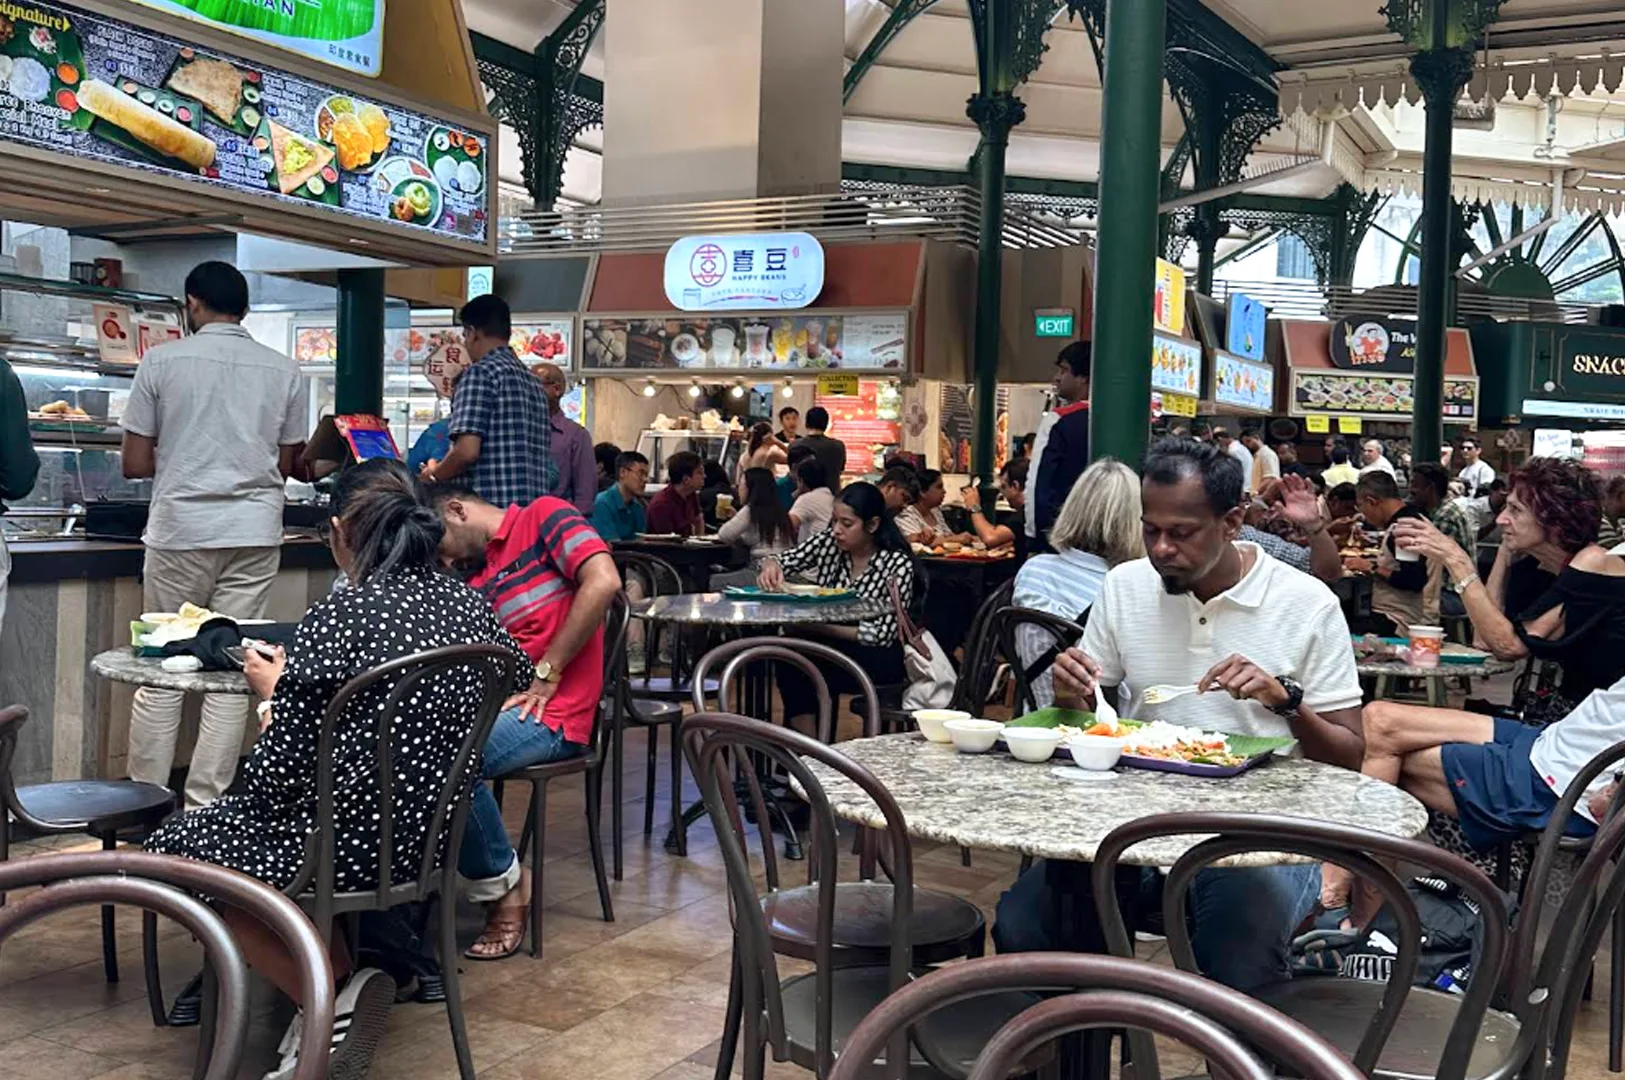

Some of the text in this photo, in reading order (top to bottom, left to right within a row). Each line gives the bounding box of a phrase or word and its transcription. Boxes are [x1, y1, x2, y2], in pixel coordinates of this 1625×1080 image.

[0, 2, 63, 31] ignature
[1045, 319, 1071, 333] EXIT
[1390, 331, 1410, 344] The
[1572, 354, 1625, 376] SNAC
